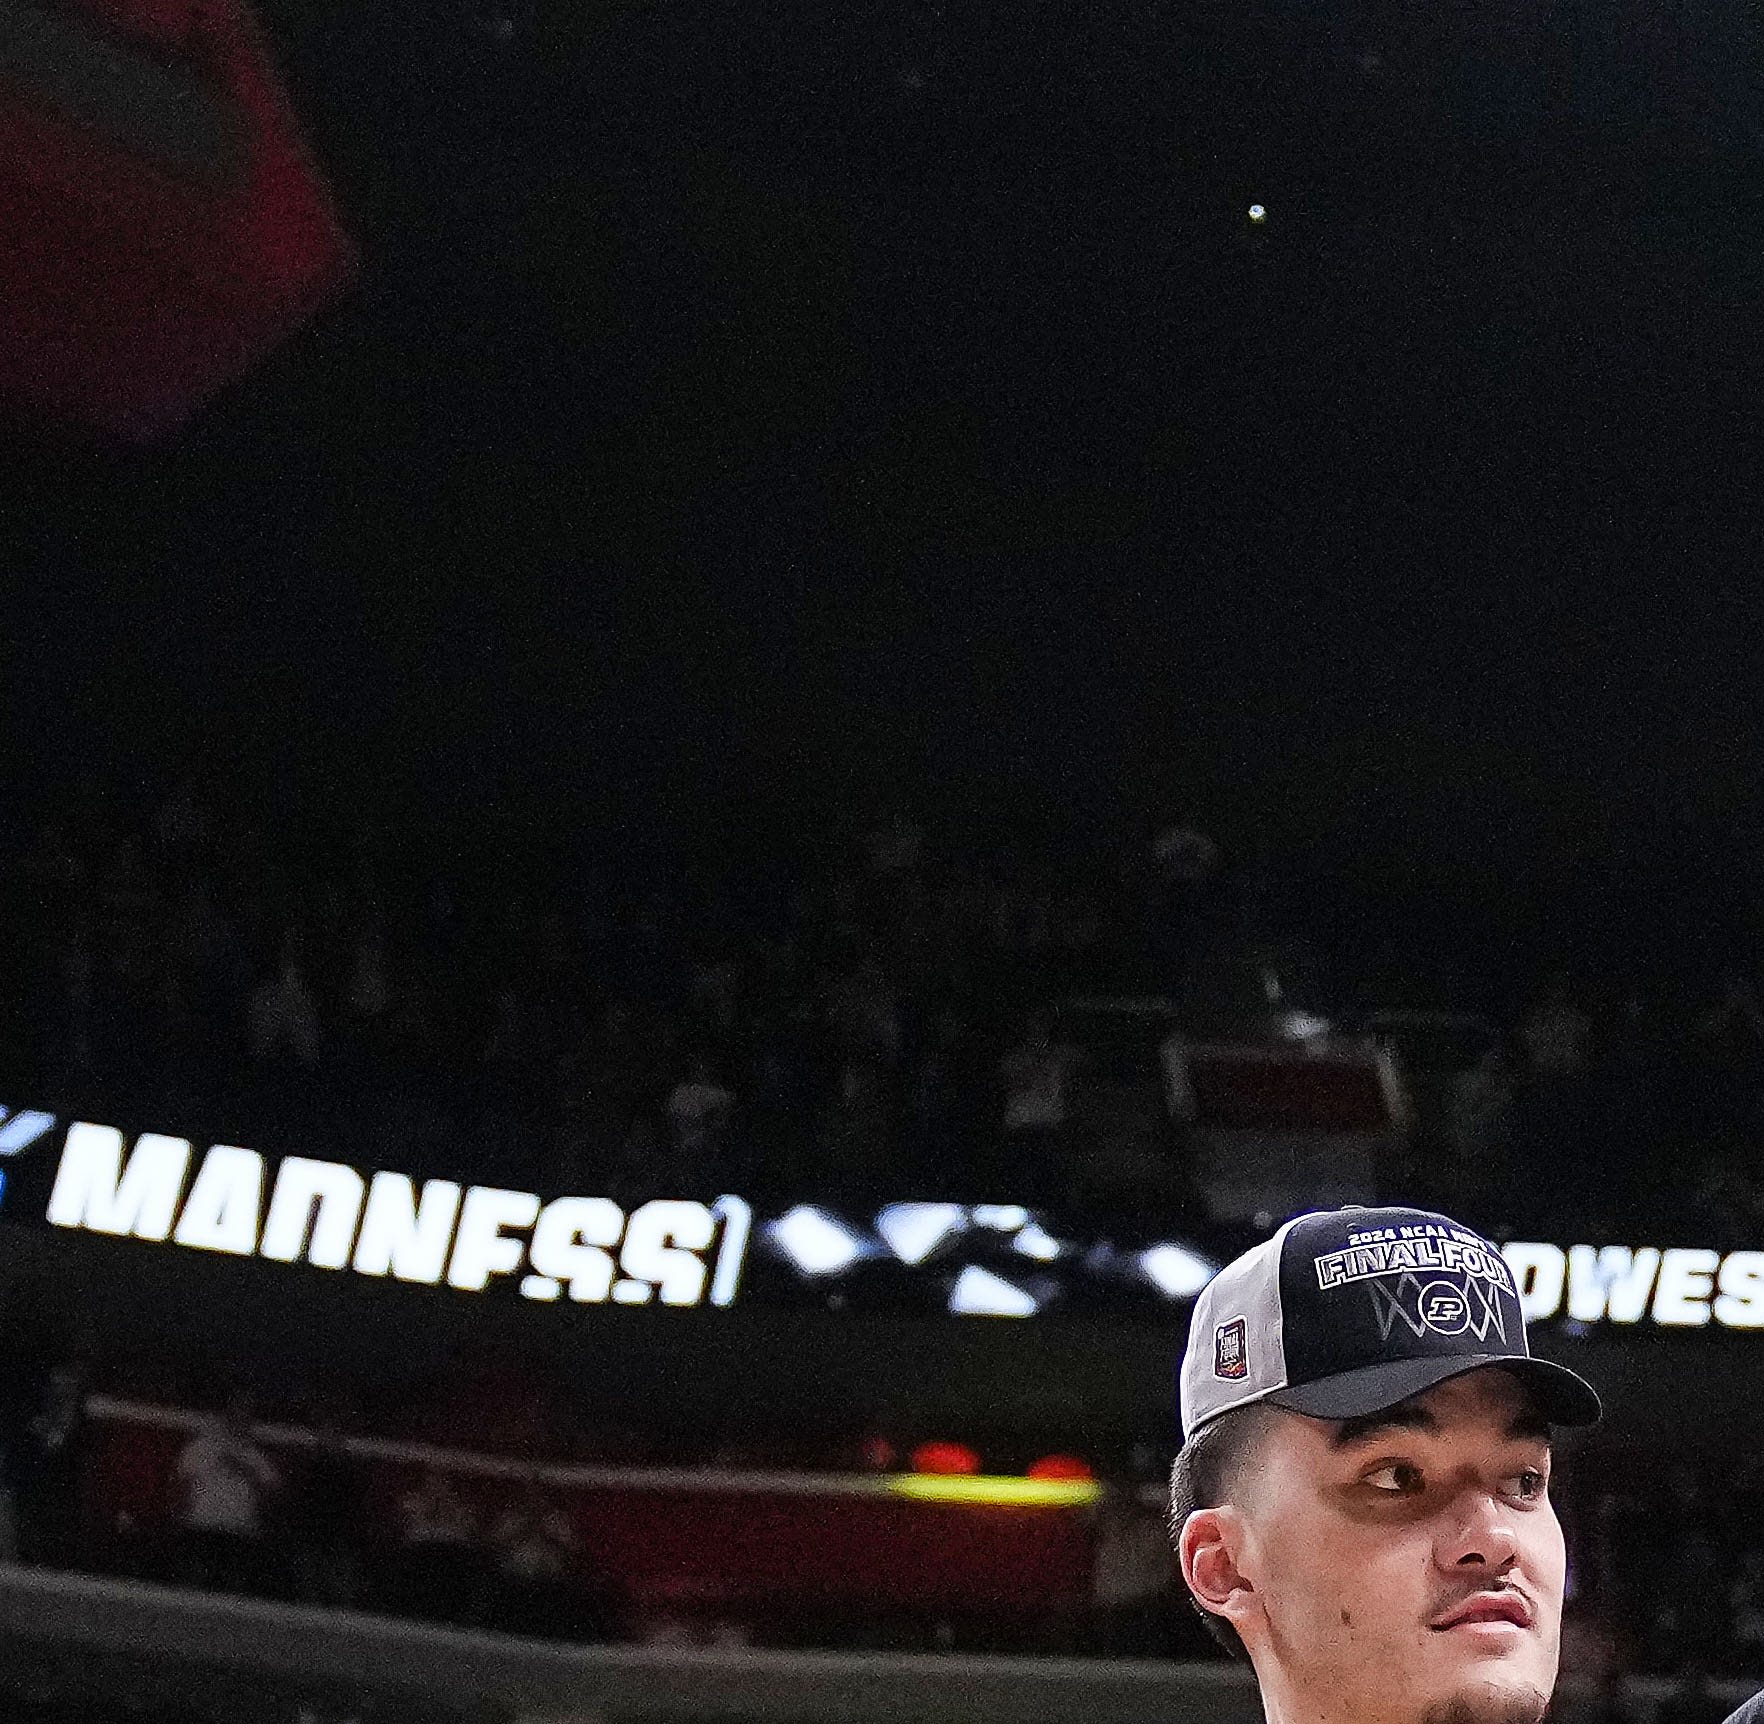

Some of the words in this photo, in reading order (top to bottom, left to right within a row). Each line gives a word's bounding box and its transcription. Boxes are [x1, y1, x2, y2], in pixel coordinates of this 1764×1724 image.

[1348, 1228, 1396, 1246] 2024
[1400, 1225, 1448, 1239] NCAA
[1318, 1240, 1440, 1286] FINAL
